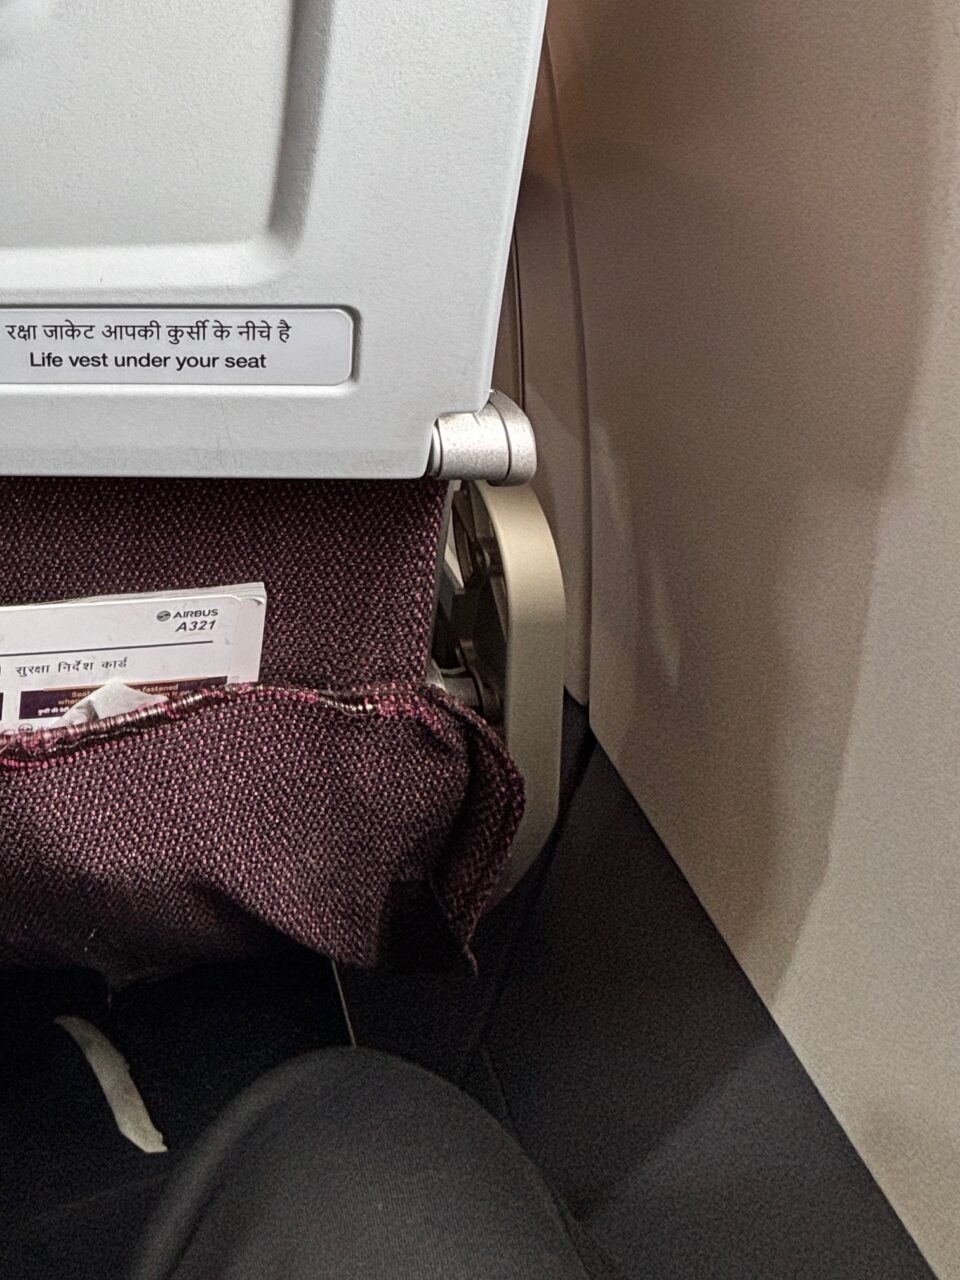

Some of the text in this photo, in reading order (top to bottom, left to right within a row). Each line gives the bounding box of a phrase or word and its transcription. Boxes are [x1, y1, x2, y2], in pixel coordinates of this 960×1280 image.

[5, 319, 292, 344] रक्षा जाकेट आपकी कुर्सी के नीचे है
[30, 352, 267, 371] Life vest under your seat
[173, 608, 219, 619] AIRBUS
[175, 619, 216, 632] A321
[15, 664, 50, 677] सुरक्षा
[101, 656, 129, 669] कार्ड
